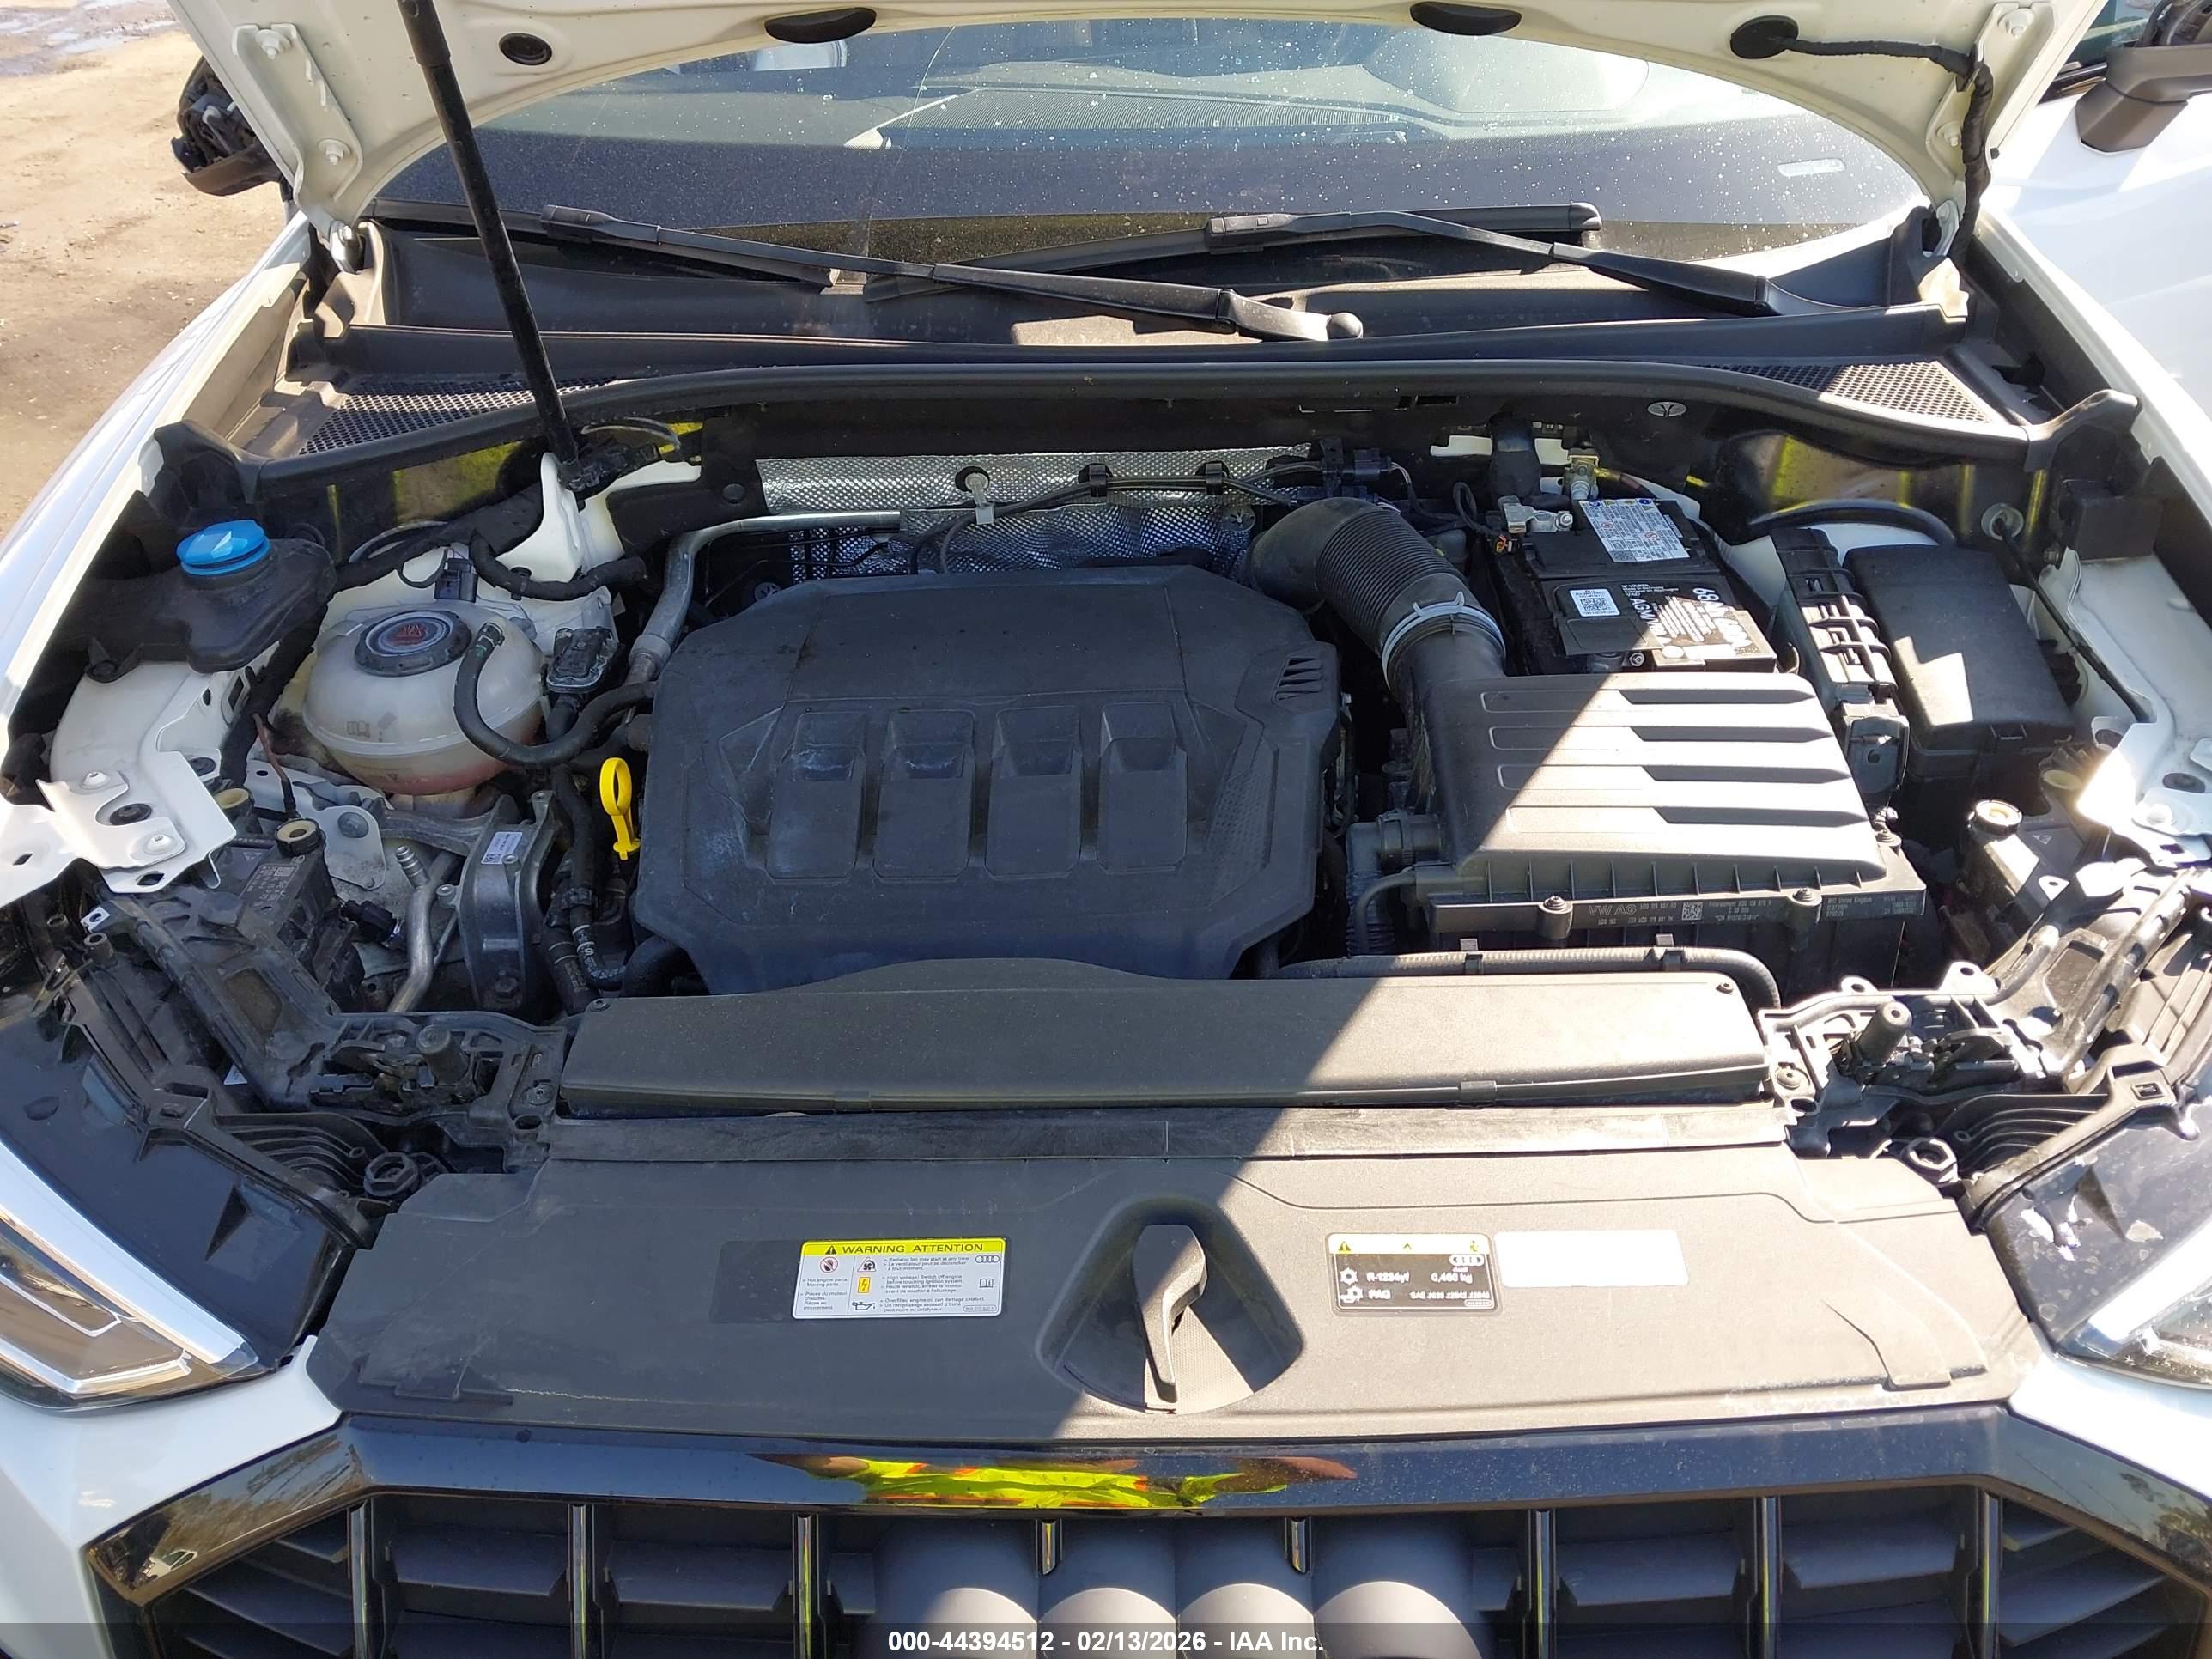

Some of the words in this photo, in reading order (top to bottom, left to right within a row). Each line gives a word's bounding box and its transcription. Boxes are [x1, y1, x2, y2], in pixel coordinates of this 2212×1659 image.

[1588, 905, 1613, 915] VW
[1614, 904, 1637, 915] AG
[842, 1244, 905, 1254] WARNING
[912, 1243, 983, 1252] ATTENTION
[1460, 1272, 1473, 1284] kg
[1368, 1289, 1391, 1299] PAG
